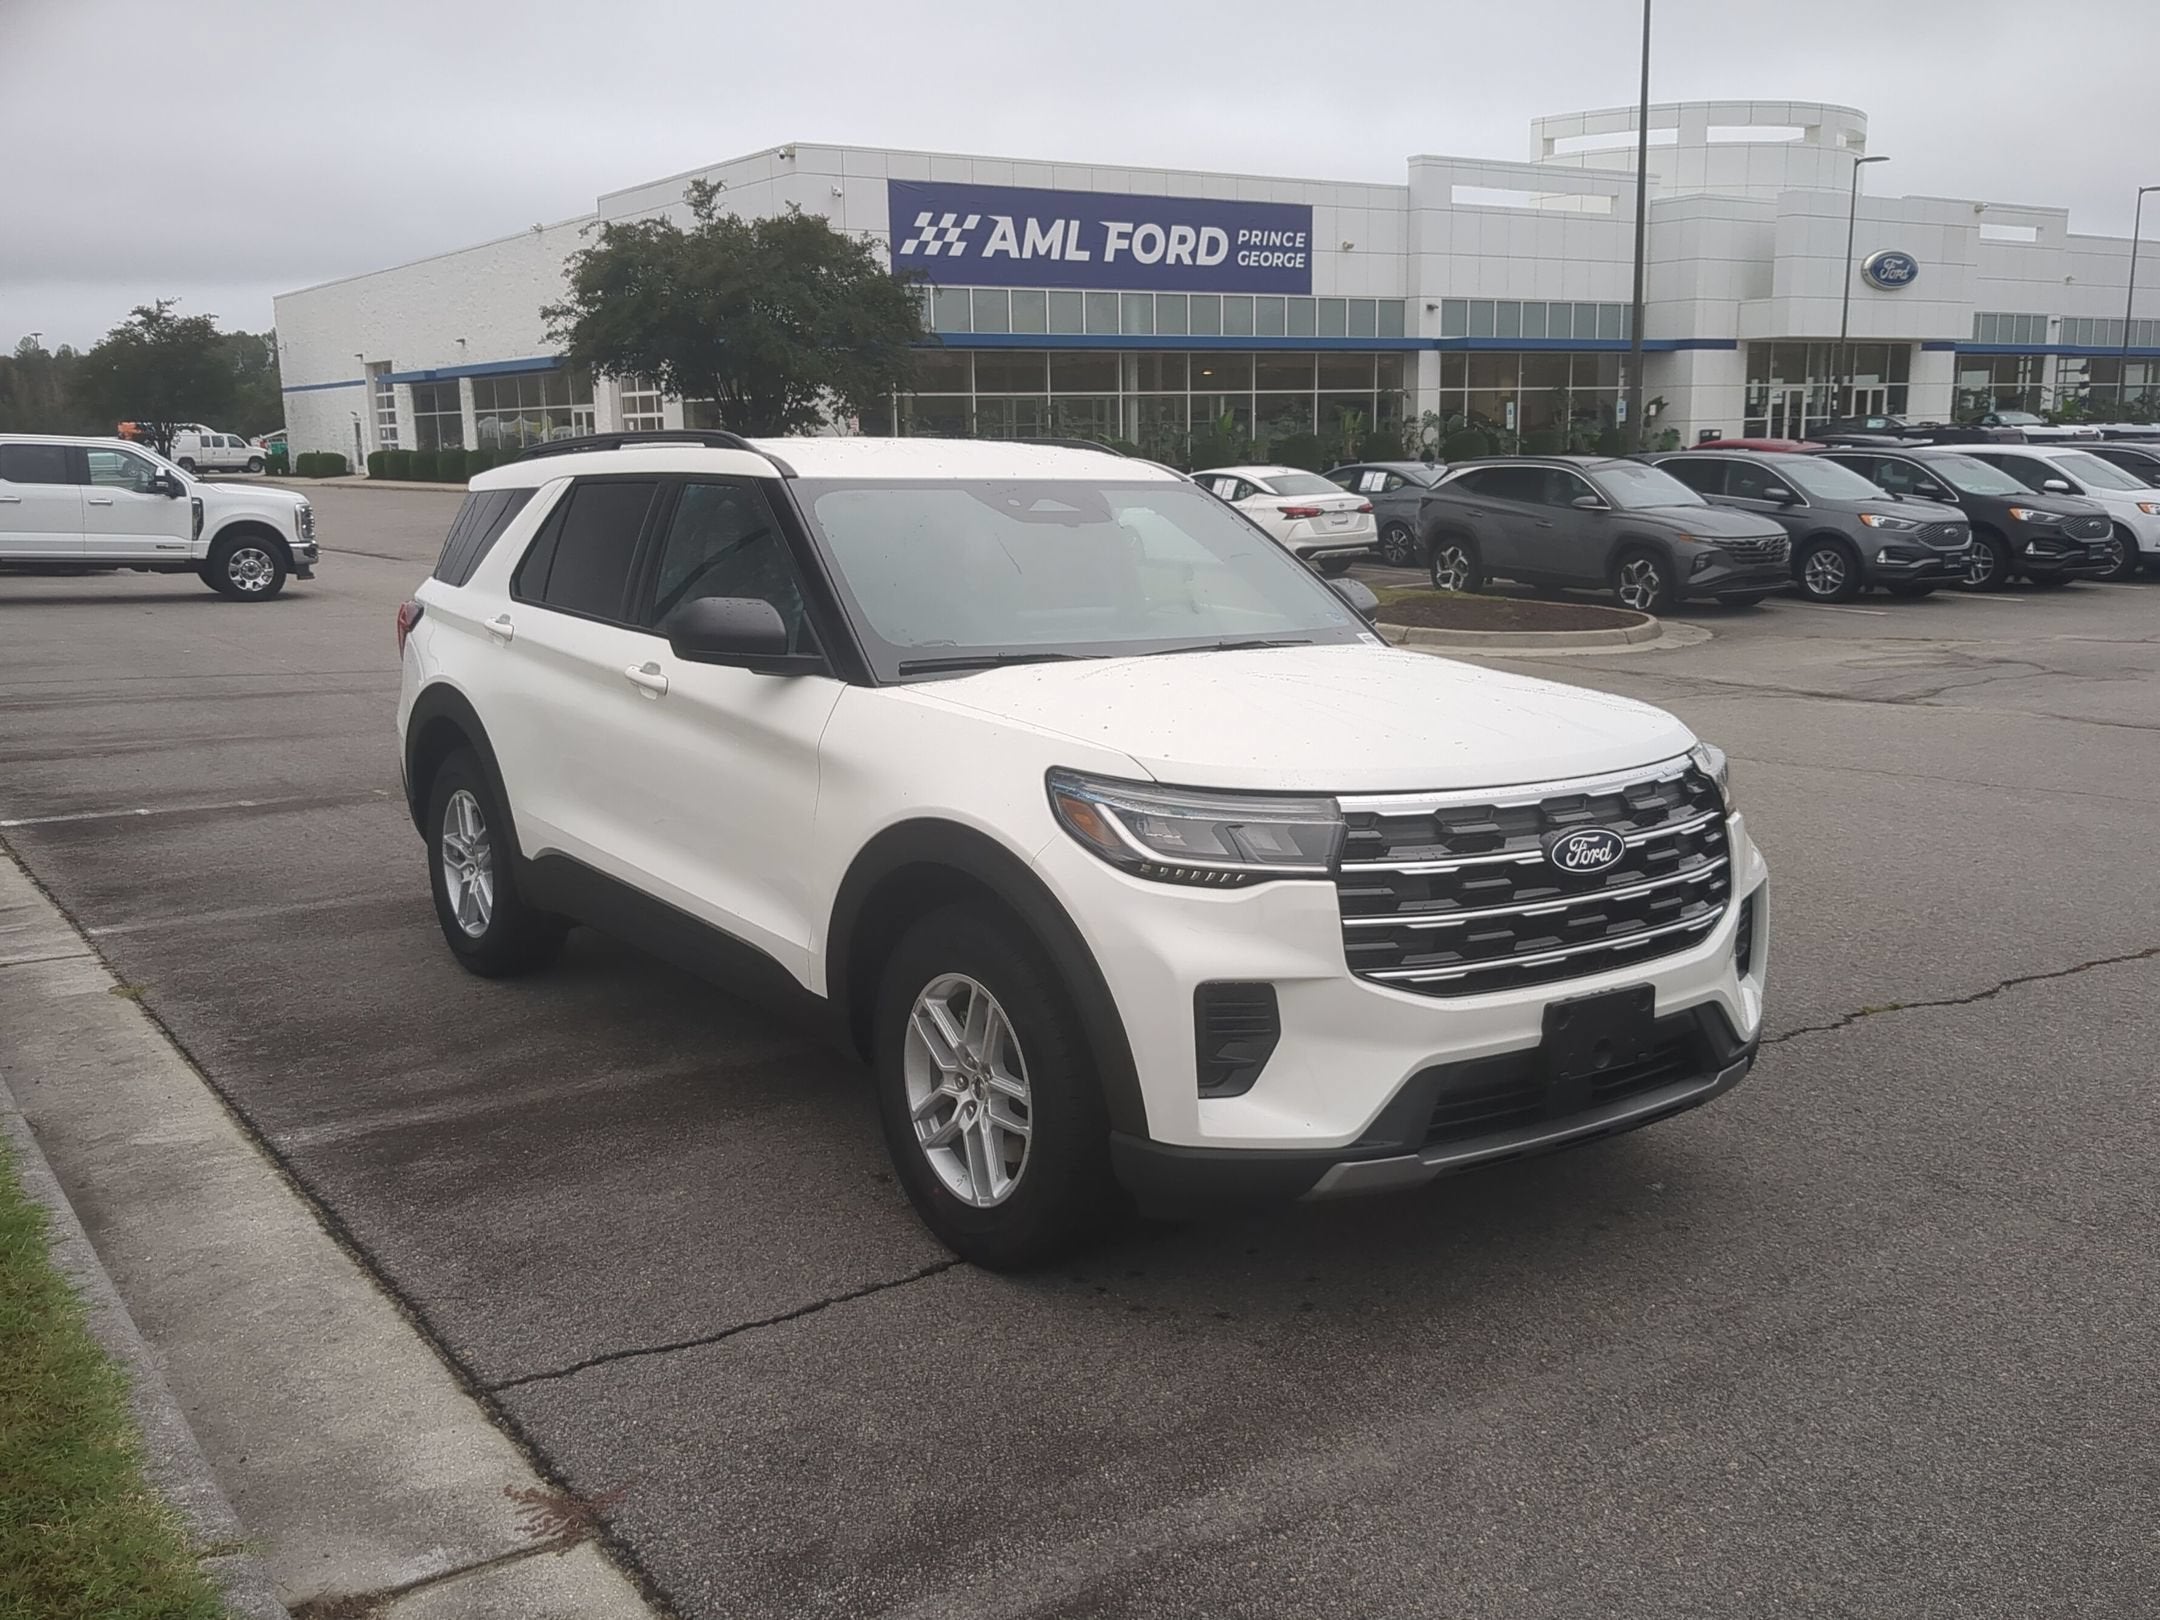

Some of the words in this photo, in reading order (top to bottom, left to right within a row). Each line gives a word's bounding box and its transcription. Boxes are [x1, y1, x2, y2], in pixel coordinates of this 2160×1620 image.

[981, 215, 1091, 261] AML
[1098, 221, 1229, 266] FORD
[1237, 229, 1306, 248] PRINCE
[1237, 250, 1306, 268] GEORGE
[1880, 258, 1911, 280] Ford
[1566, 835, 1612, 867] Ford
